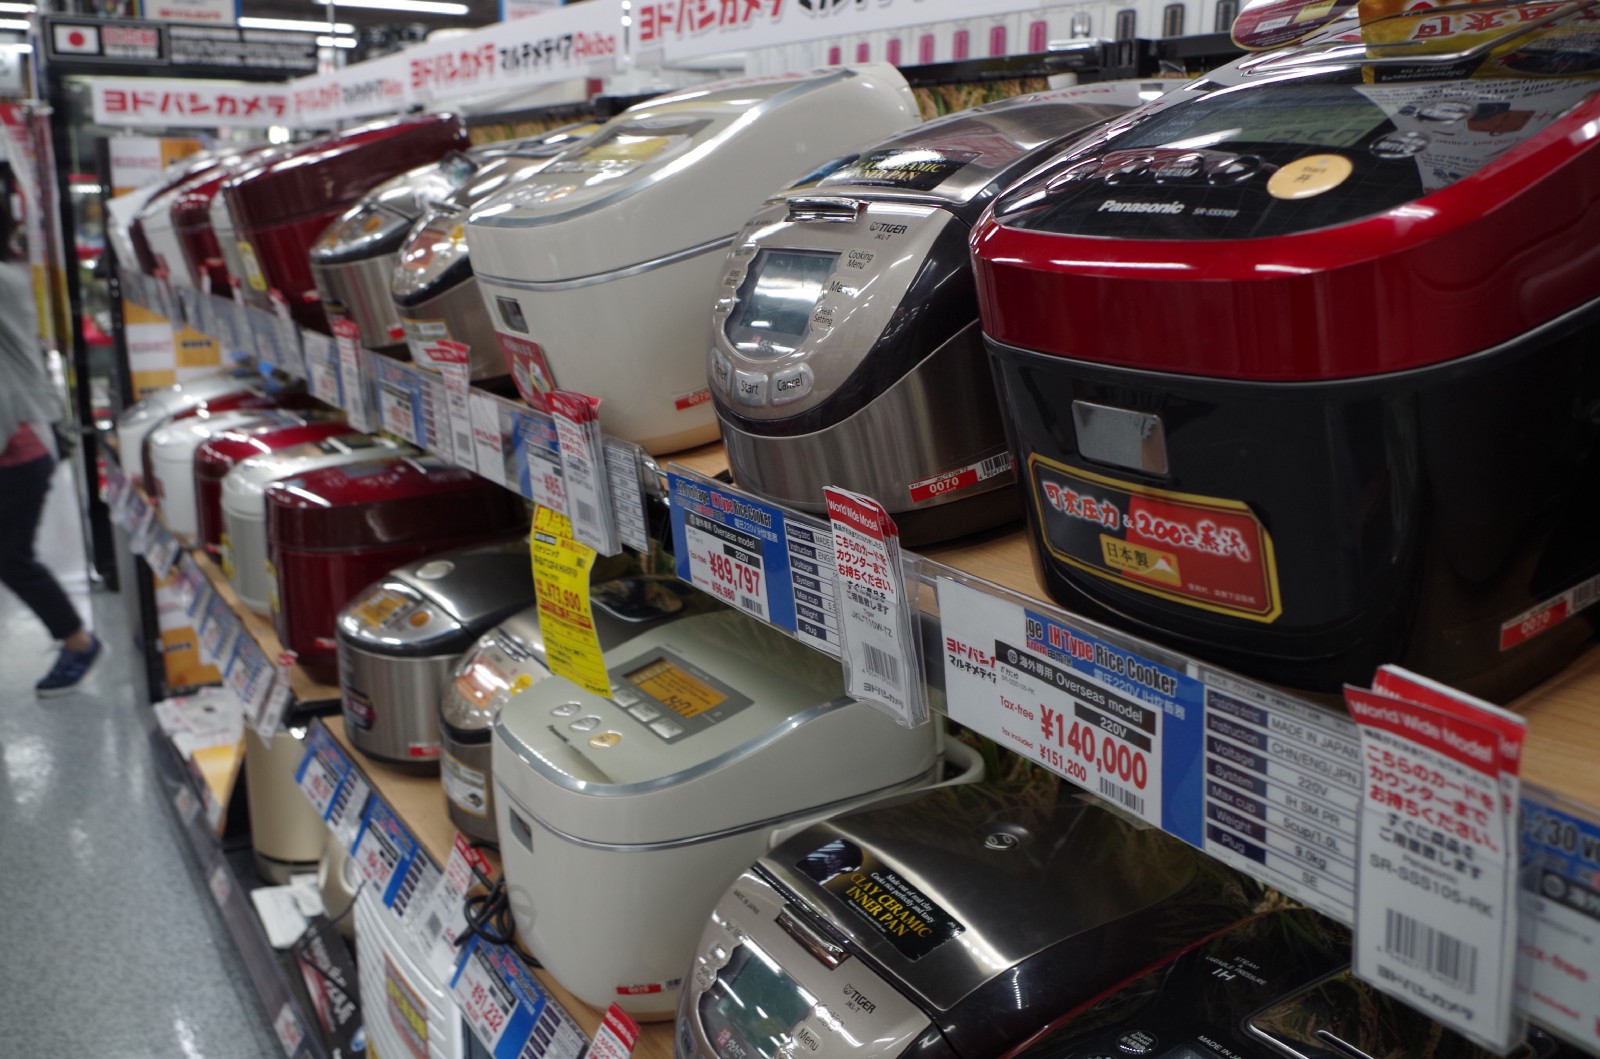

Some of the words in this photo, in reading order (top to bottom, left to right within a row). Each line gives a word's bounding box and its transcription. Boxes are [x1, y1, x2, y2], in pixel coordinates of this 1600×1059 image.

[411, 43, 496, 88] ヨドバシカメラ
[104, 90, 287, 117] ヨドバシカメラ
[1097, 200, 1185, 214] Panasonic
[879, 223, 907, 234] TIGER
[846, 259, 865, 270] Menu
[848, 251, 874, 264] Cooking
[813, 314, 833, 326] Setting
[818, 308, 833, 317] Heat
[740, 380, 759, 395] Start
[776, 373, 803, 392] Cancel
[929, 476, 960, 493] 0070
[733, 499, 748, 521] Rice
[748, 504, 772, 529] Cooker
[828, 500, 847, 515] World
[846, 506, 859, 522] Wide
[860, 513, 878, 531] Model
[1042, 481, 1121, 530] 可変圧力
[1123, 514, 1135, 529] &
[713, 525, 737, 542] Overseas
[737, 536, 756, 549] model
[789, 542, 812, 556] Instruction
[735, 551, 749, 562] 220V
[835, 534, 887, 566] こちらのカードを
[1106, 542, 1149, 568] 日本製
[708, 551, 761, 597] ¥89,797
[793, 559, 813, 572] Voltage
[836, 549, 888, 577] カウンターまで
[795, 575, 815, 588] System
[837, 563, 894, 594] お持ちください。
[796, 590, 807, 601] Max
[808, 596, 819, 606] cup
[800, 607, 818, 620] Weight
[1521, 610, 1551, 634] 0070
[805, 624, 817, 636] Plug
[1025, 618, 1043, 640] ge
[1048, 623, 1062, 649] IH
[1062, 629, 1094, 662] Type
[1095, 643, 1125, 675] Rice
[1126, 656, 1178, 698] Cooker
[1019, 655, 1053, 681] 海外専用
[1056, 672, 1105, 705] Overseas
[1108, 697, 1143, 723] model
[1000, 696, 1034, 721] Tax-free
[1001, 727, 1011, 738] Tax
[1011, 732, 1034, 749] included
[1100, 716, 1127, 738] 220V
[1210, 717, 1260, 745] Instruction
[1271, 717, 1304, 740] MADE
[1307, 727, 1318, 743] IN
[1321, 735, 1359, 760] JAPAN
[1350, 701, 1400, 724] World
[1400, 711, 1441, 738] Wide
[1442, 728, 1492, 763] Model
[1040, 704, 1148, 790] ¥140,000
[1214, 741, 1255, 767] Voltage
[1039, 743, 1087, 782] ¥151,200
[1271, 742, 1357, 784] CHN/ENG/JPN
[1215, 764, 1254, 790] System
[1298, 776, 1328, 797] 220V
[1367, 743, 1495, 811] こちらのカードを
[1212, 786, 1234, 806] Max
[1235, 796, 1256, 813] cup
[1368, 764, 1489, 827] カウンターまで
[1216, 809, 1252, 833] Weight
[1285, 794, 1297, 808] IH
[1300, 800, 1319, 818] SM
[1322, 809, 1340, 826] PR
[1221, 833, 1245, 854] Plug
[850, 873, 882, 896] CLAY
[878, 893, 933, 938] CERAMIC
[870, 872, 885, 885] Cooks
[884, 882, 895, 892] rice
[892, 889, 914, 907] perfectly
[911, 904, 923, 914] and
[921, 911, 936, 923] tasty
[887, 874, 900, 886] Made
[921, 901, 933, 912] clay
[846, 886, 883, 917] INNER
[879, 912, 910, 937] PAN
[1211, 968, 1237, 981] IH
[1233, 956, 1260, 970] STEAM
[1233, 967, 1268, 986] PRESSURE
[850, 989, 877, 1015] TIGER
[797, 1028, 819, 1051] Menu
[1197, 1035, 1223, 1051] MADE
